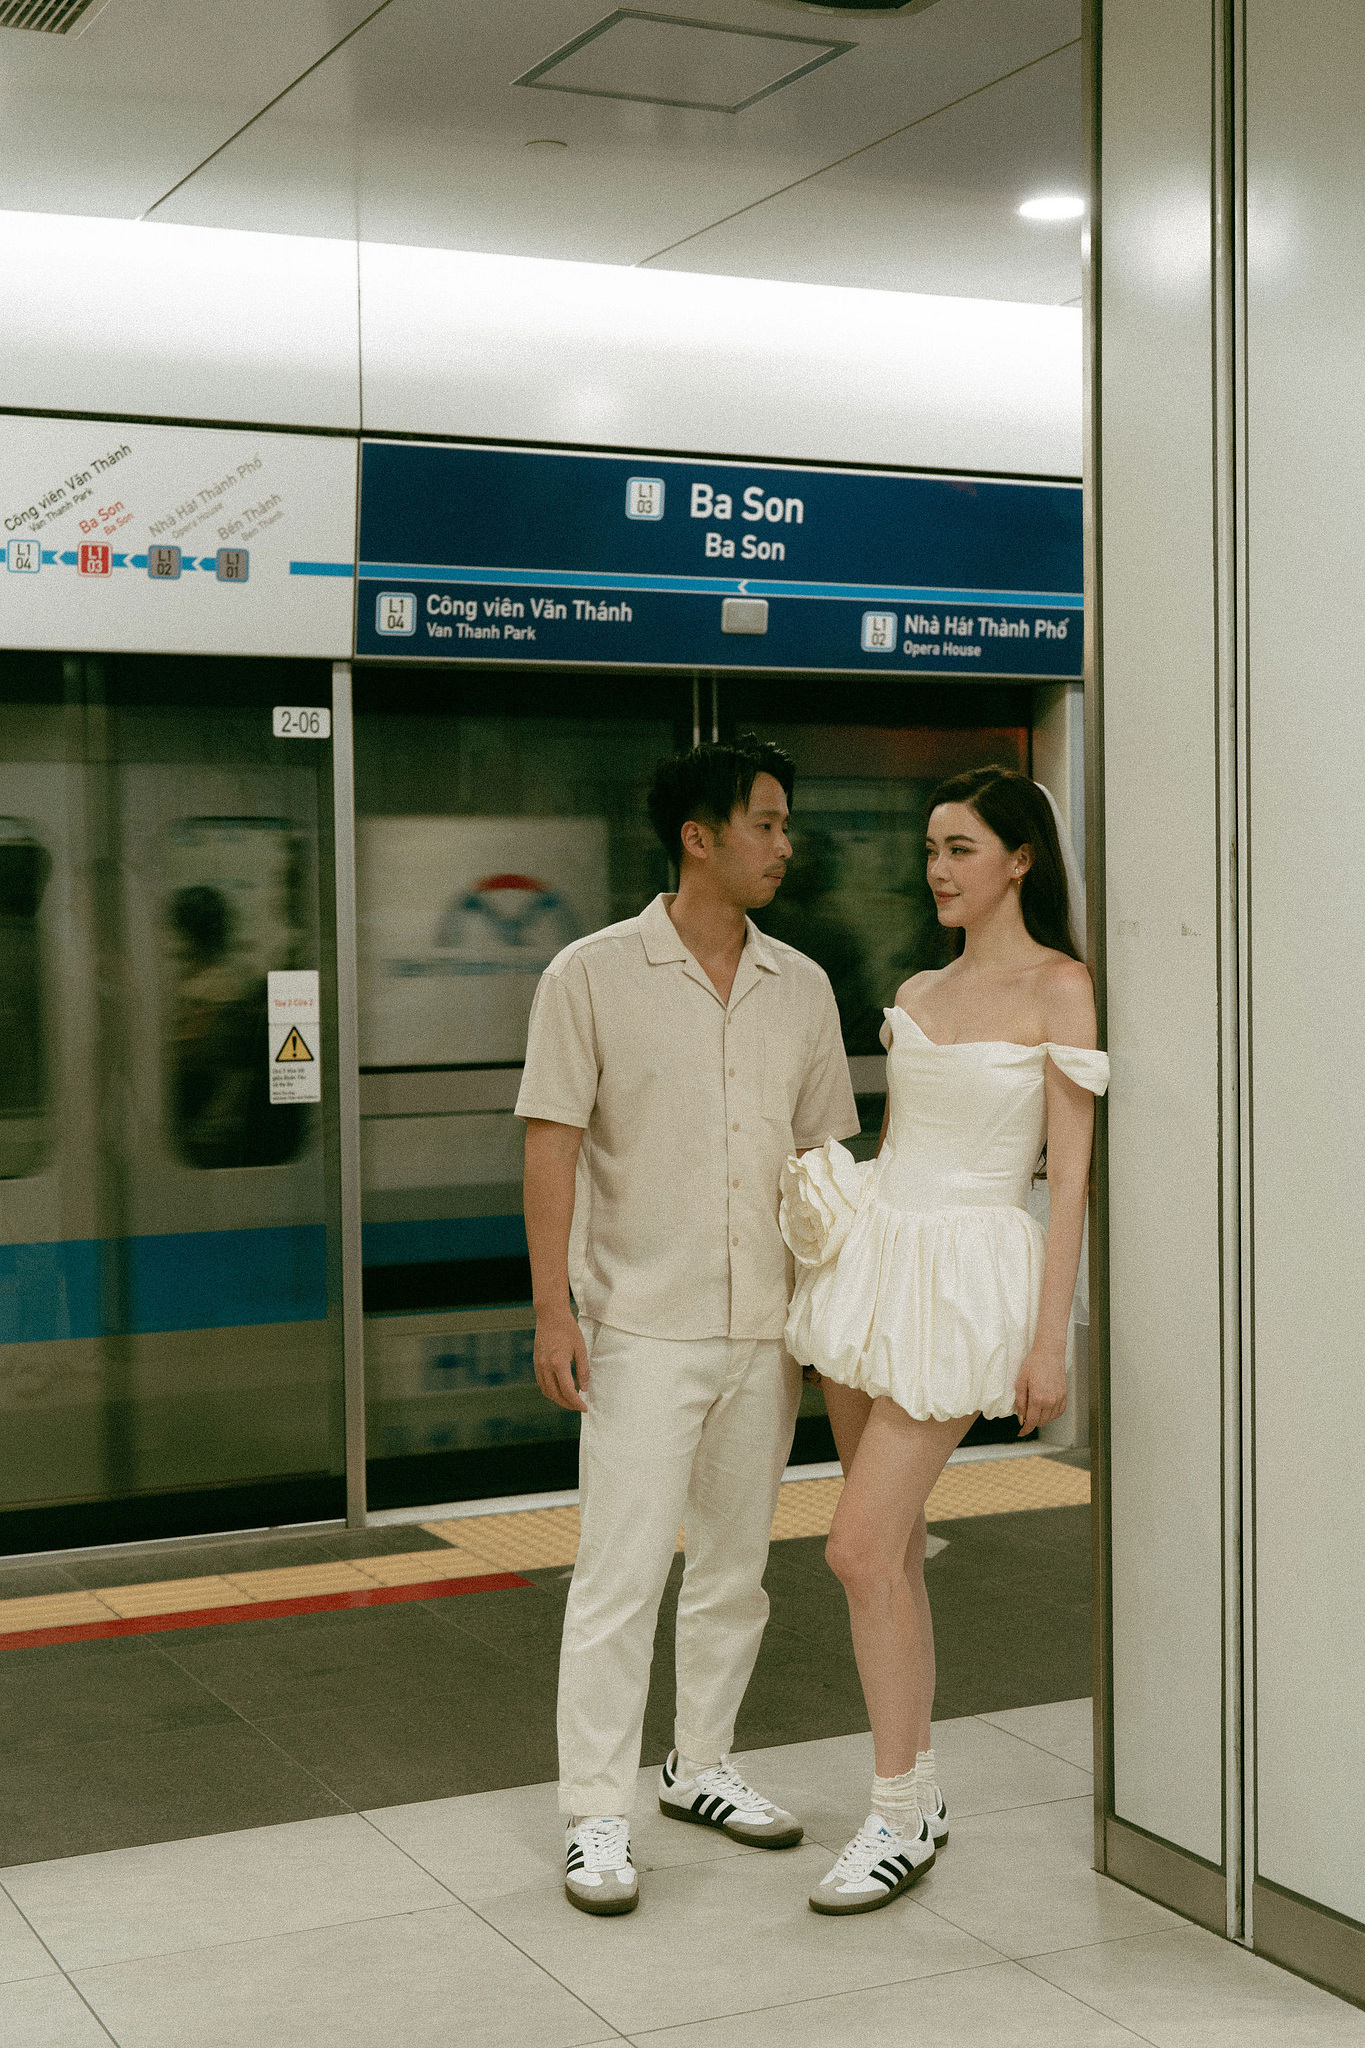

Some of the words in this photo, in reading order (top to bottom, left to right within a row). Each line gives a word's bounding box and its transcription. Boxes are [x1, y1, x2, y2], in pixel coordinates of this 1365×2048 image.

[4, 506, 40, 531] Công
[38, 488, 67, 509] viên
[64, 471, 93, 490] Văn
[90, 444, 132, 474] Thánh
[638, 484, 653, 499] L1
[636, 499, 653, 514] 03
[690, 483, 733, 520] Ba
[741, 486, 804, 524] Son
[78, 518, 99, 534] Ba
[97, 501, 125, 522] Son
[103, 524, 117, 536] Ba
[116, 512, 135, 527] Son
[17, 543, 31, 556] L1
[88, 546, 103, 560] L1
[705, 532, 735, 559] Ba
[740, 534, 786, 561] Son
[15, 556, 32, 570] 04
[158, 550, 172, 562] L1
[226, 552, 240, 565] L1
[87, 560, 103, 573] 03
[157, 563, 172, 576] 02
[225, 566, 240, 578] 01
[388, 598, 405, 614] L1
[426, 594, 479, 621] Công
[483, 596, 524, 619] viên
[529, 597, 567, 620] Văn
[573, 600, 633, 622] Thánh
[387, 615, 405, 630] 04
[873, 617, 887, 632] L1
[904, 614, 940, 635] Nhà
[944, 616, 974, 636] Hát
[977, 617, 1030, 638] Thành
[1035, 617, 1070, 640] Phố
[427, 623, 453, 638] Van
[457, 624, 500, 639] Thanh
[504, 625, 536, 641] Park
[871, 632, 887, 646] 02
[903, 640, 939, 657] Opera
[943, 641, 982, 657] House
[281, 711, 320, 733] 2-06
